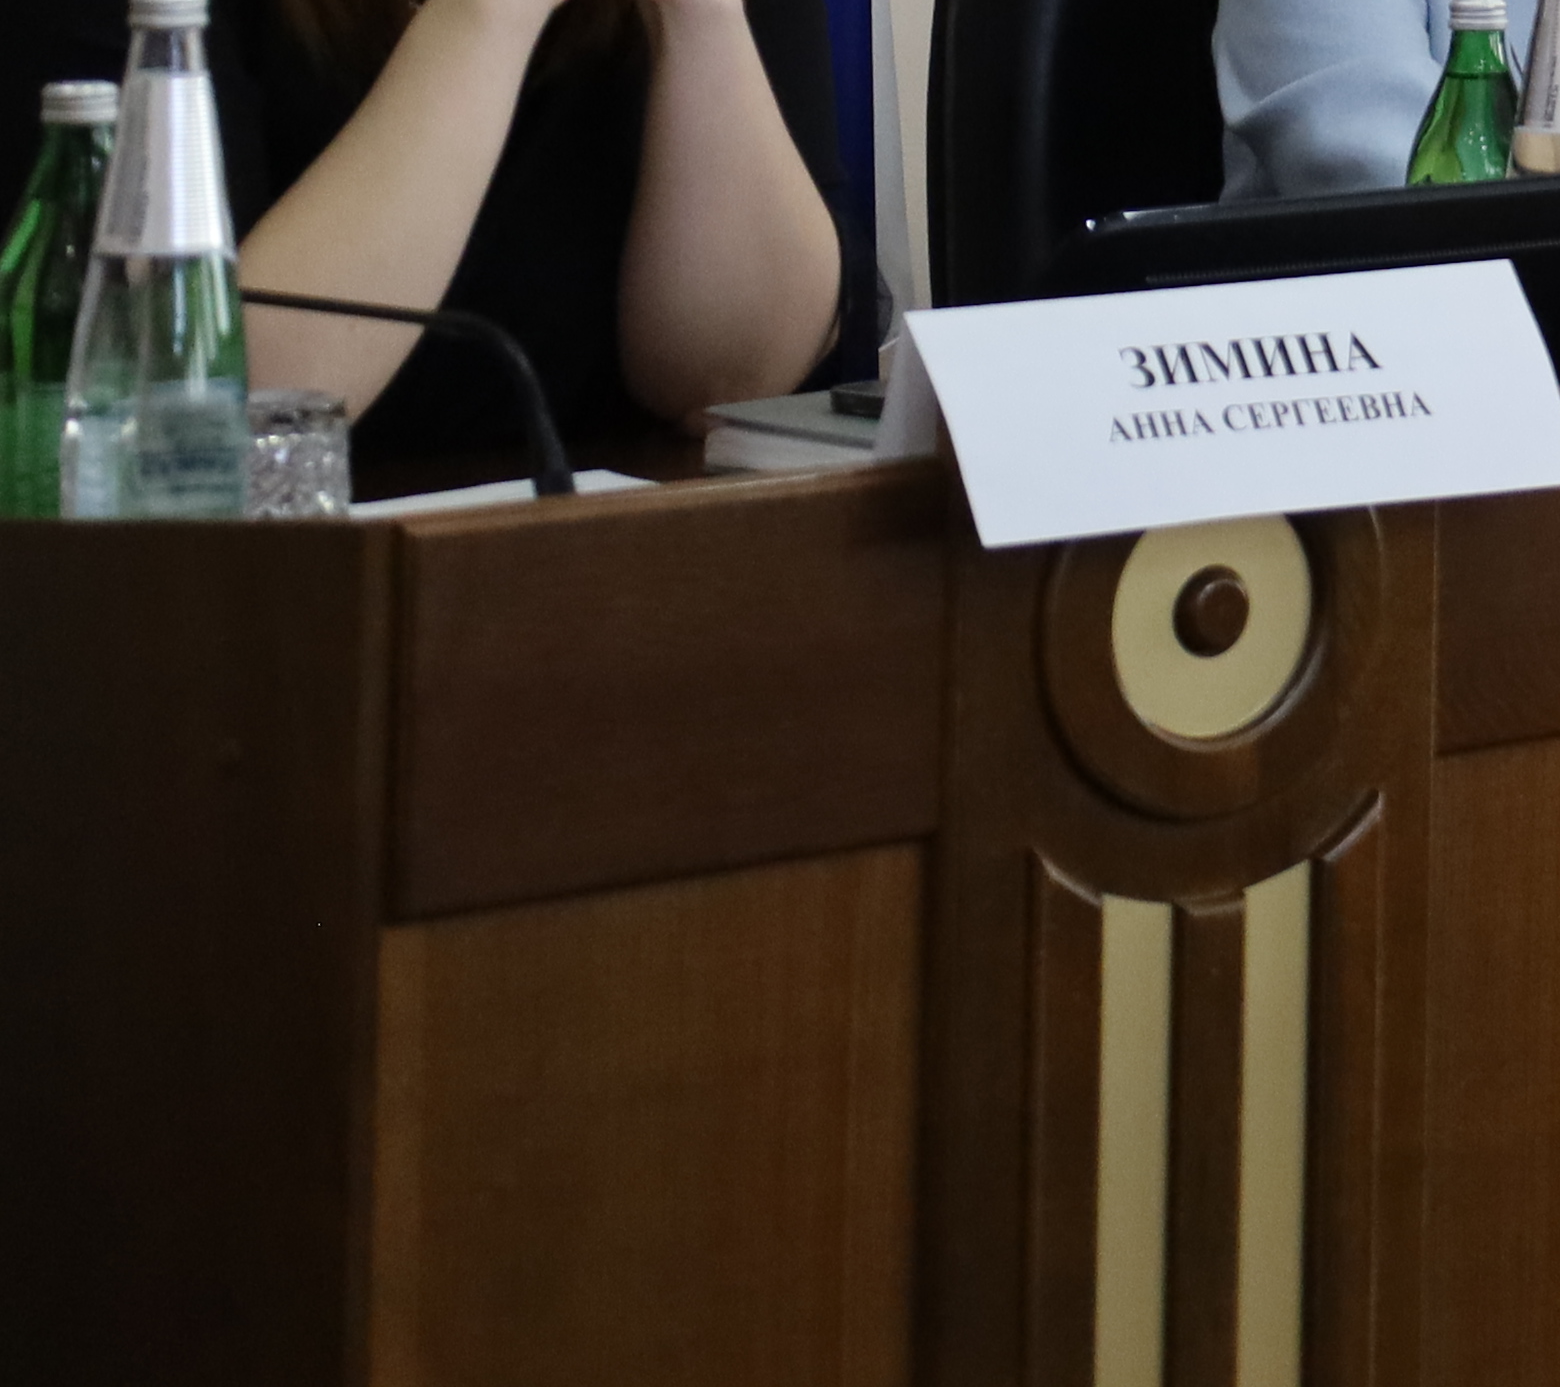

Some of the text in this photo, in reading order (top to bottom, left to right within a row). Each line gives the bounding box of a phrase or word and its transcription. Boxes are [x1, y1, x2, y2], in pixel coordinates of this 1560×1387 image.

[1117, 331, 1384, 389] ЗИМИНА
[1107, 390, 1434, 442] АННА СЕРГЕЕВНА
